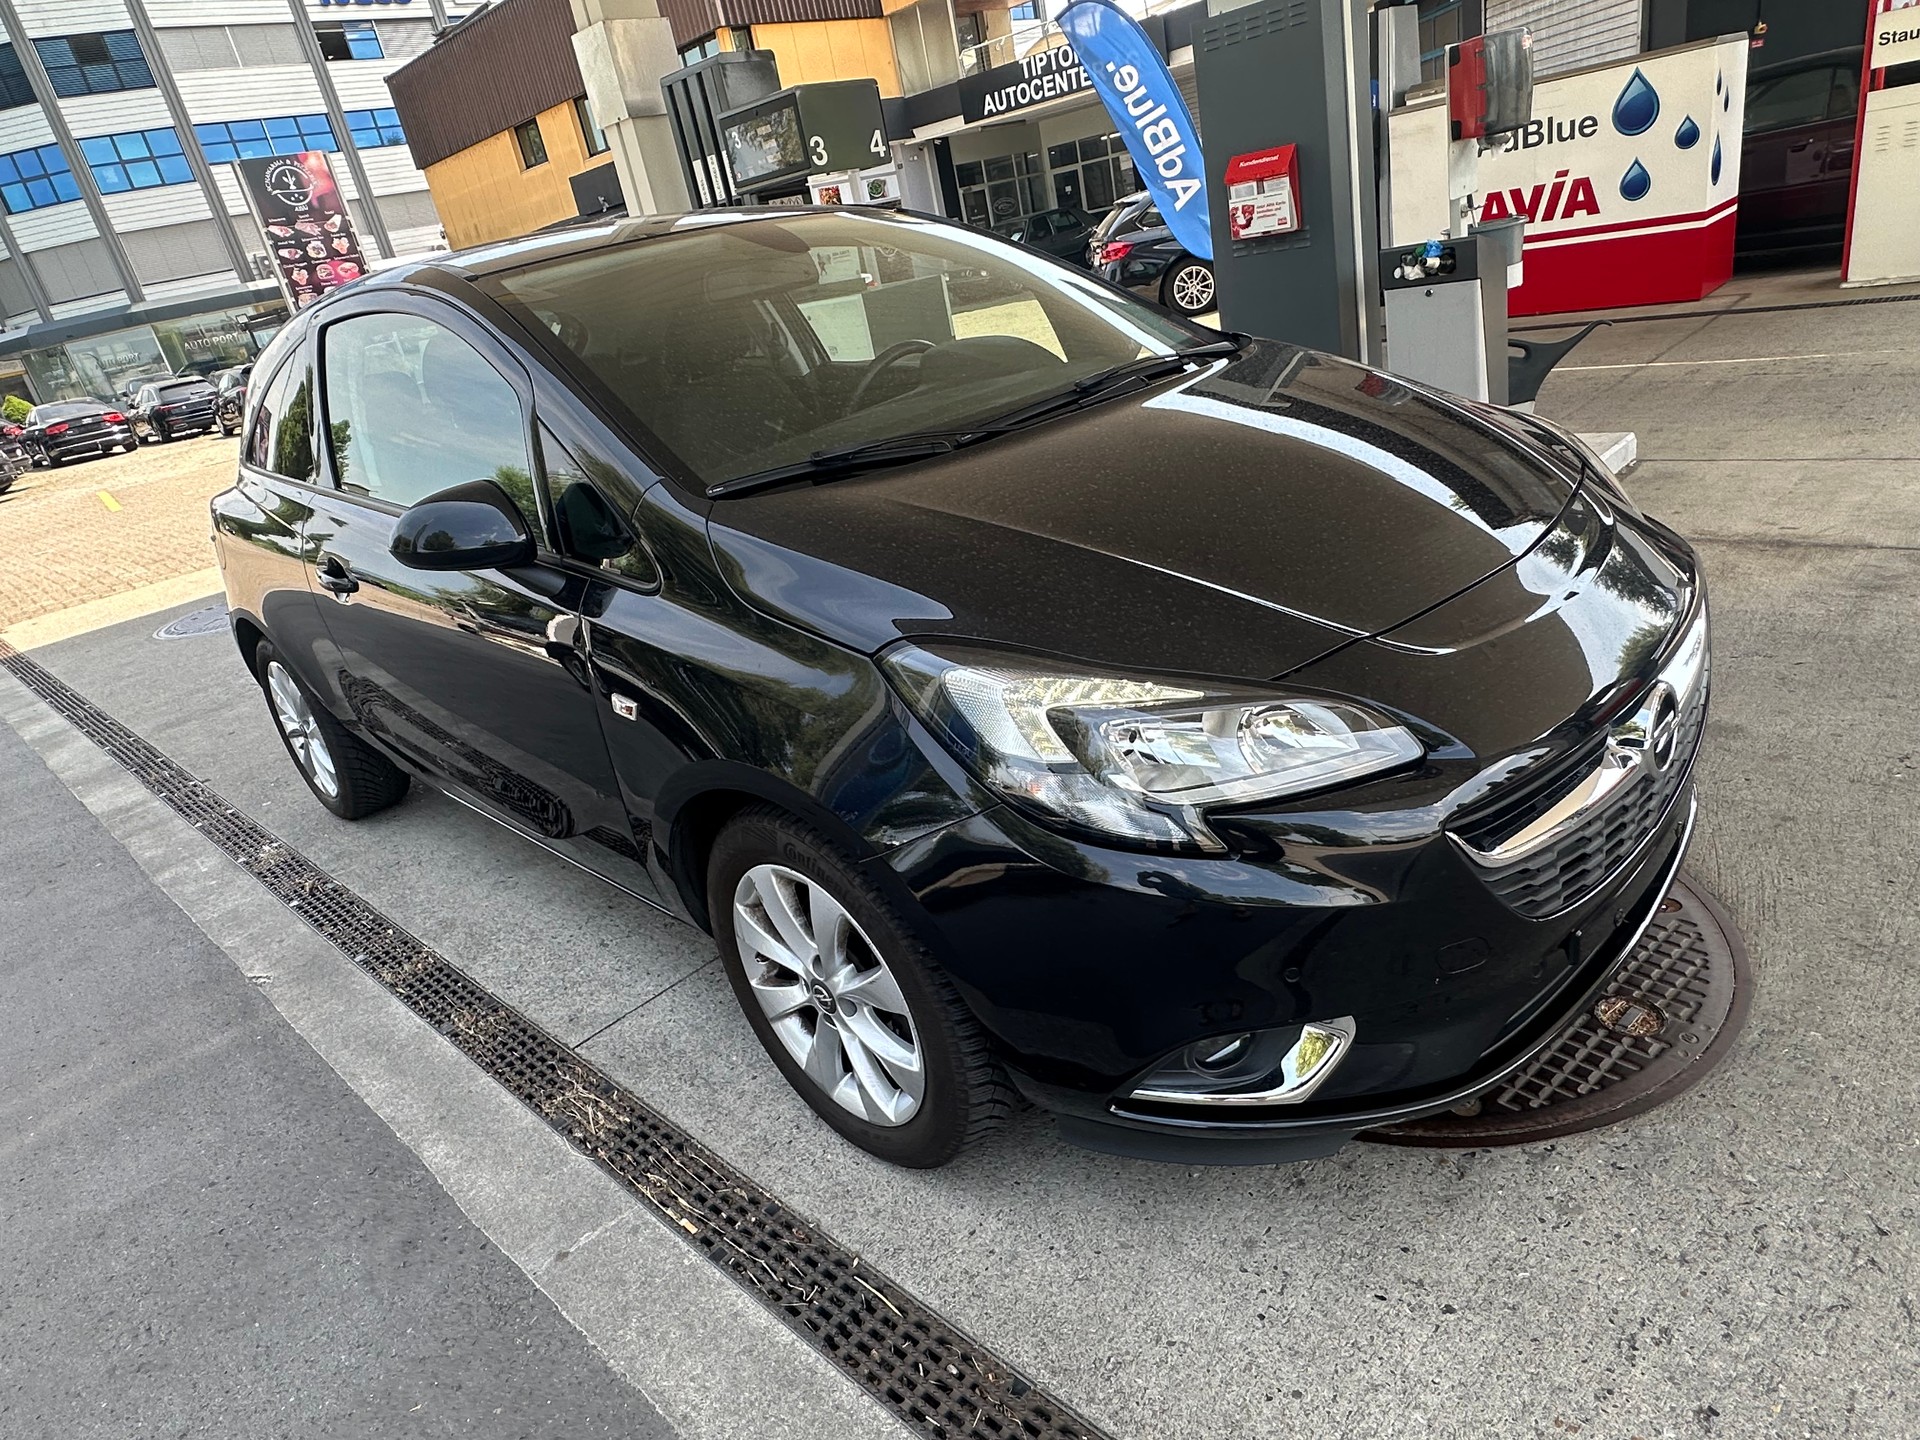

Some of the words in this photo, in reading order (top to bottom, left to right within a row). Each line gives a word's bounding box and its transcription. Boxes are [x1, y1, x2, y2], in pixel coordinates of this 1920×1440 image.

[1018, 45, 1081, 79] TIPTO
[982, 67, 1095, 116] AUTOCENTE
[731, 131, 742, 150] 3
[809, 135, 829, 166] 3
[869, 129, 887, 158] 4
[1239, 154, 1280, 168] Kundendienst
[184, 339, 211, 352] AUTO
[212, 332, 239, 346] PORT
